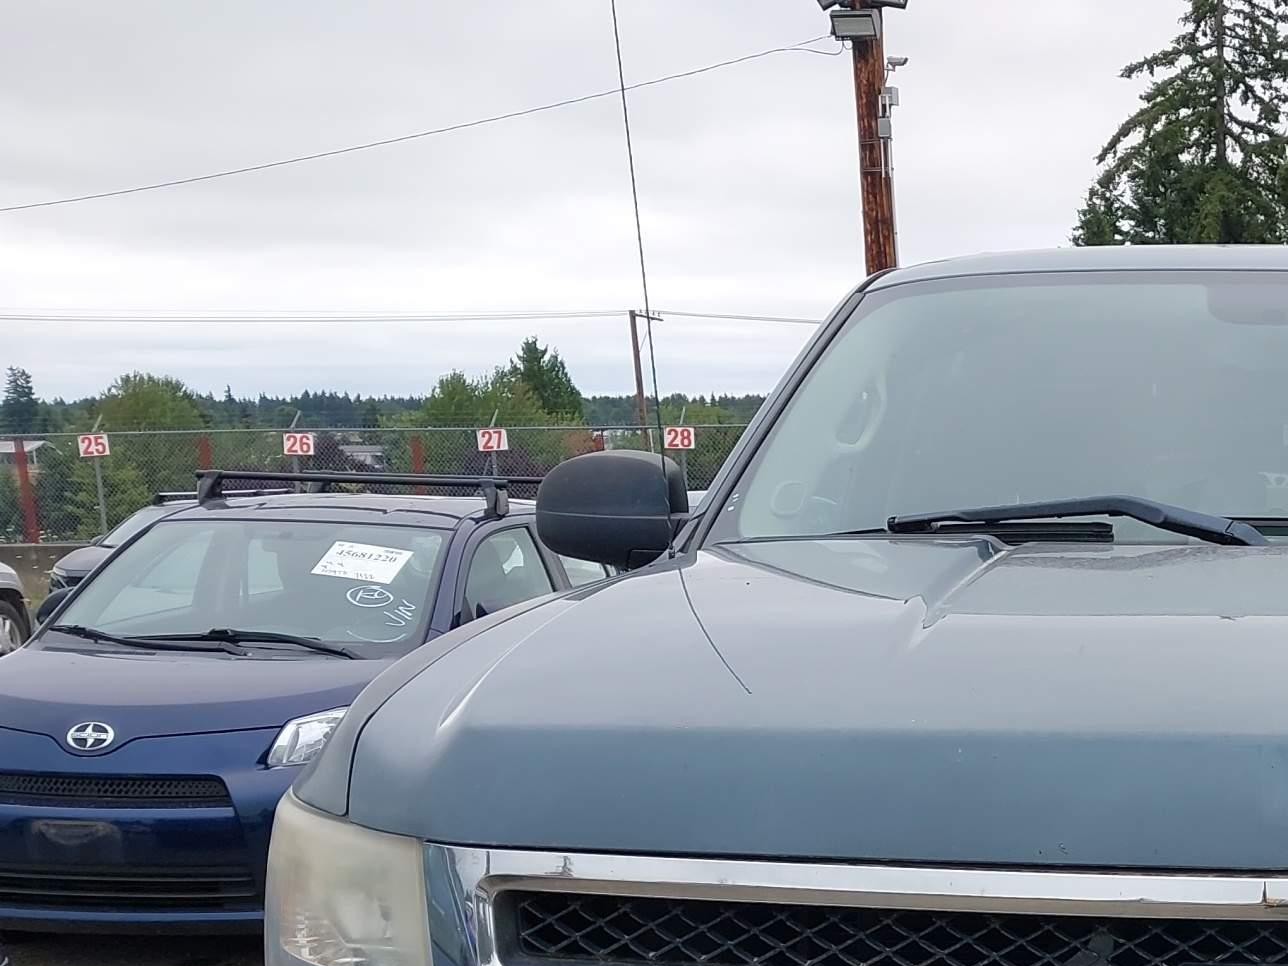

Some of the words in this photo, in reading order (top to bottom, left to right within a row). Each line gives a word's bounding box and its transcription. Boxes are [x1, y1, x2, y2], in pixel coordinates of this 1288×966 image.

[83, 437, 107, 455] 25
[288, 436, 310, 453] 26
[484, 432, 507, 450] 27
[669, 429, 692, 449] 28
[336, 549, 397, 563] 45681220
[384, 599, 417, 627] VIN
